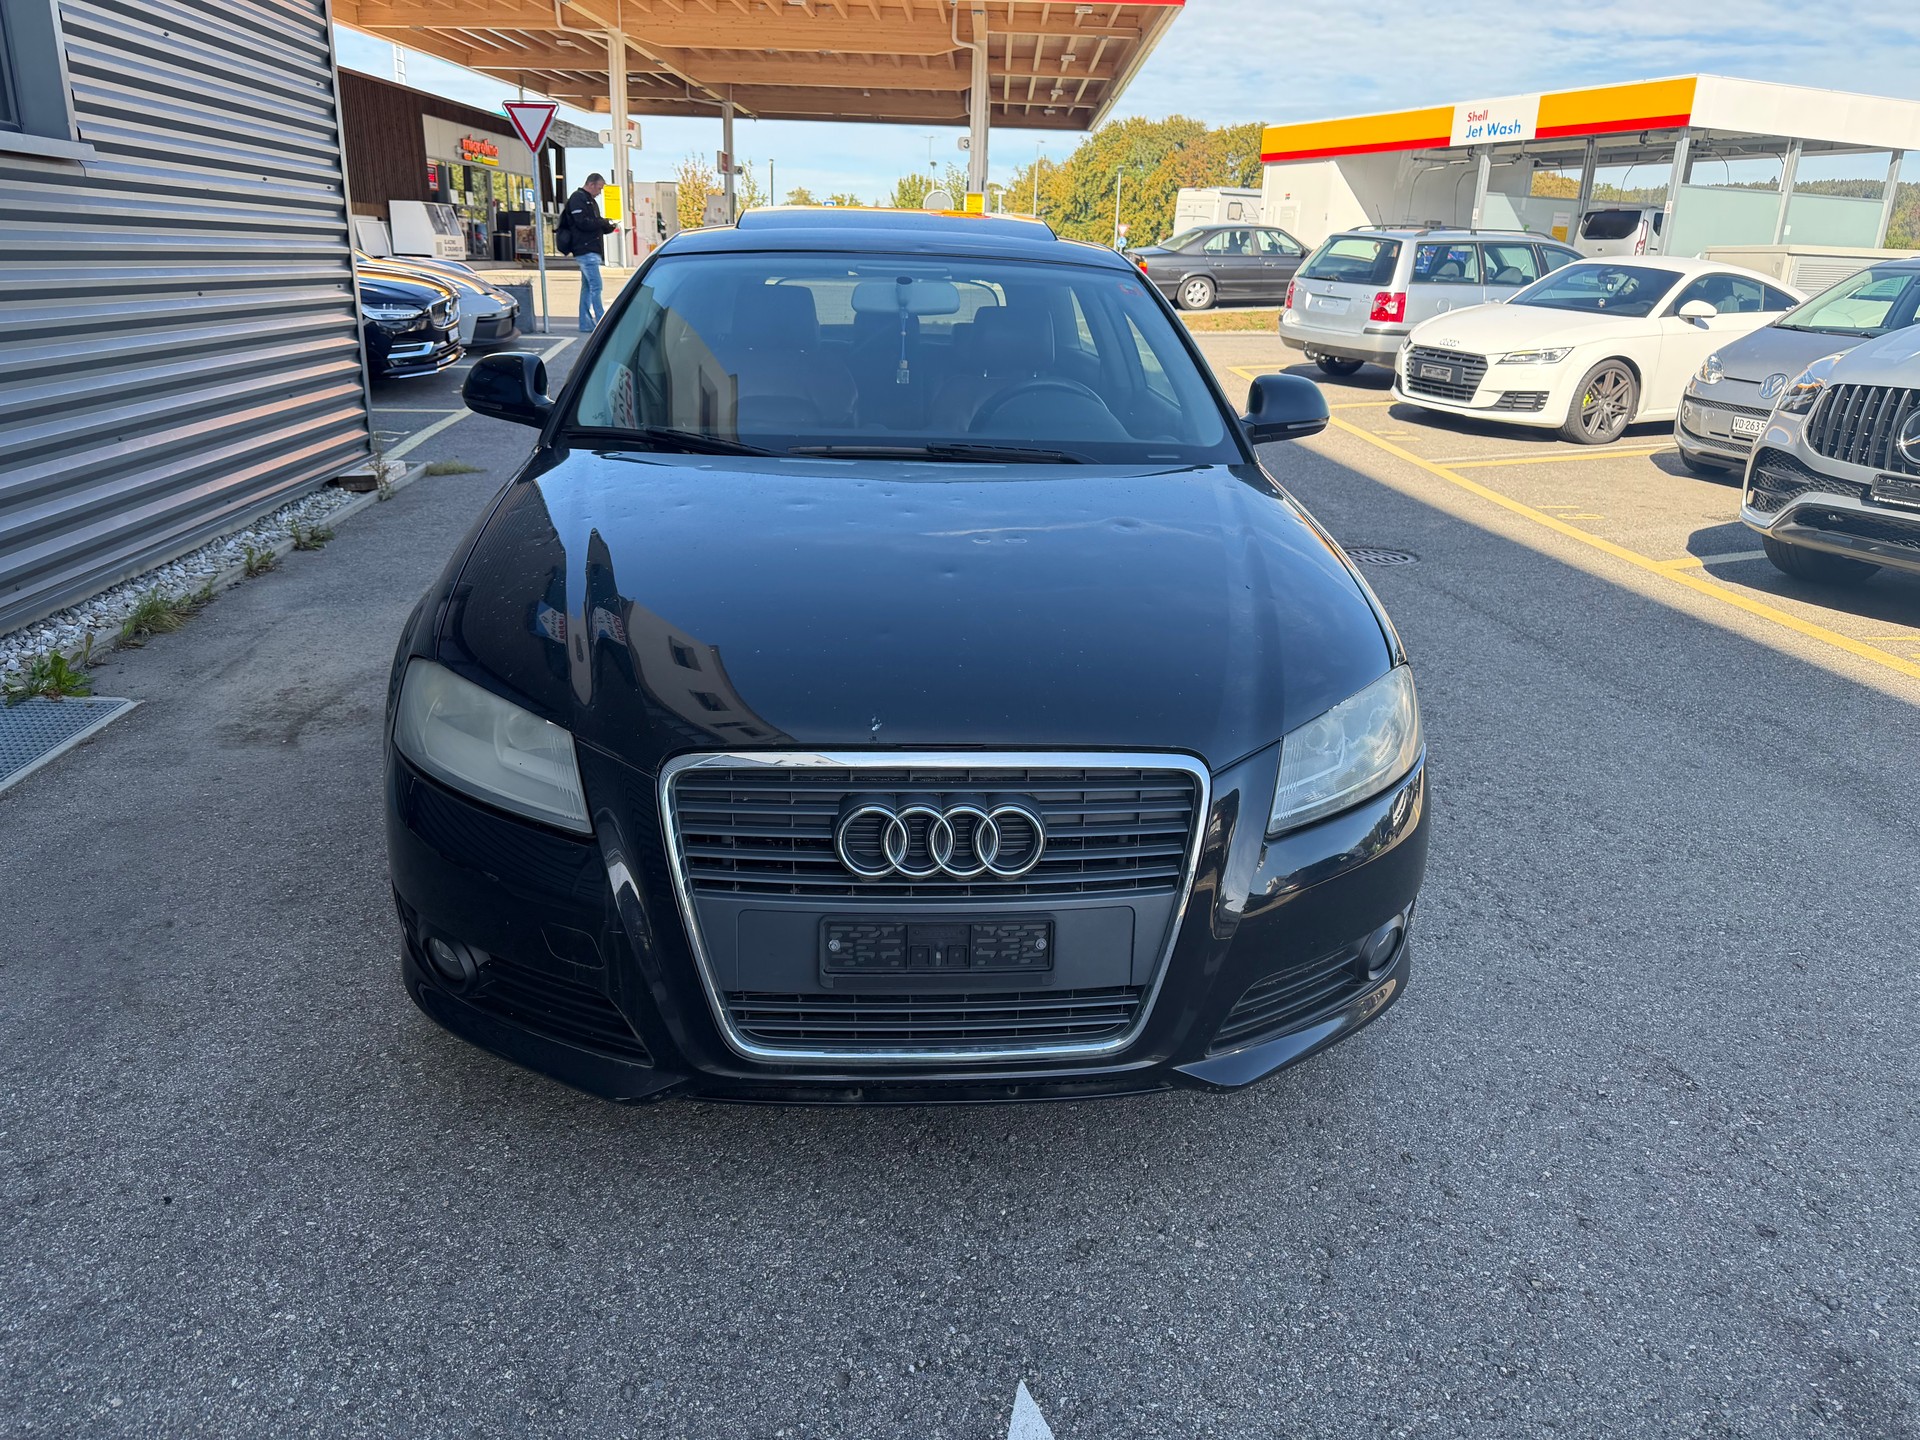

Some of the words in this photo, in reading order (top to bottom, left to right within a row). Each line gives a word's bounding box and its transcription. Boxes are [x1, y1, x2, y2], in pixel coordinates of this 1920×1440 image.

[1467, 110, 1488, 122] Shell
[1466, 123, 1483, 138] Jet
[1487, 119, 1521, 136] Wash
[625, 133, 632, 143] 2
[963, 139, 970, 149] 3
